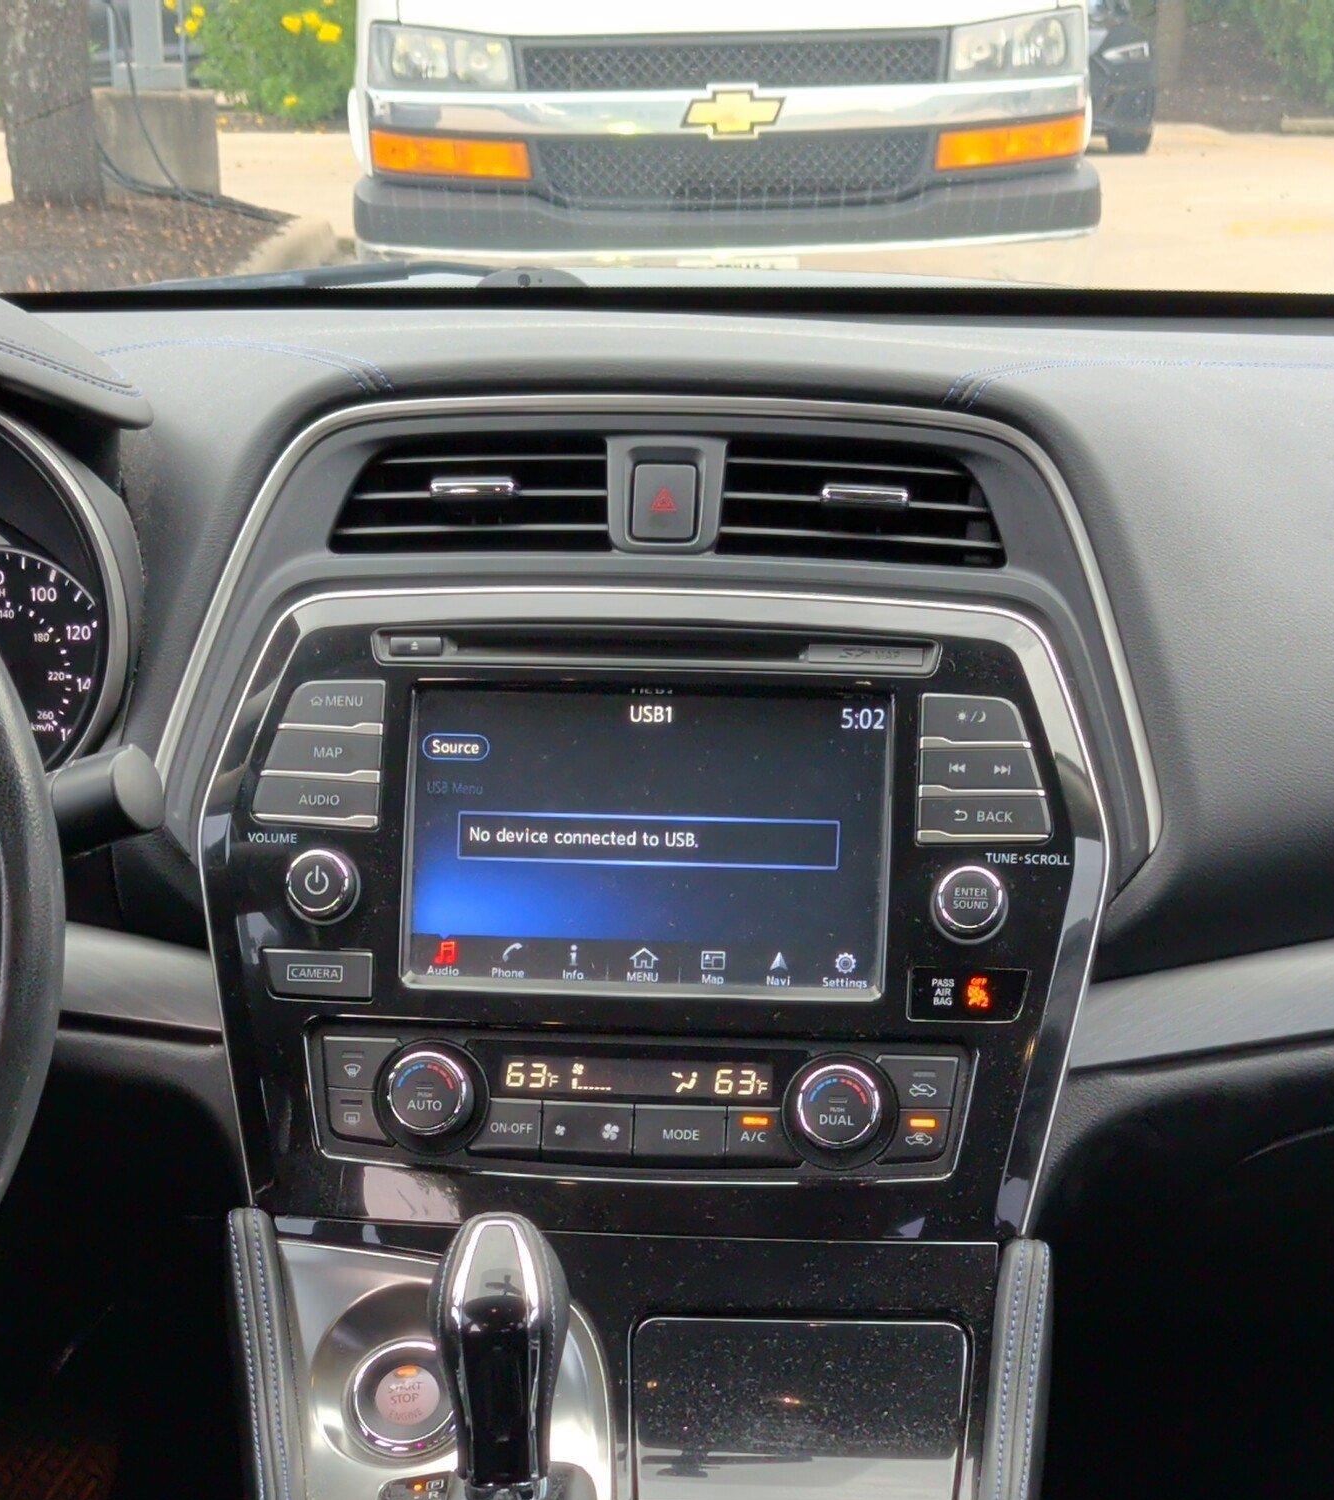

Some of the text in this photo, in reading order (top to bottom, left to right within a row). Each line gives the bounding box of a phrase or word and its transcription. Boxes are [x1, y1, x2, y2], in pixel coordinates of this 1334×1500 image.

[30, 587, 57, 602] 100
[33, 632, 50, 643] 180
[66, 625, 91, 641] 120
[47, 671, 65, 682] 220
[324, 695, 364, 707] MENU
[37, 710, 54, 721] 260
[629, 705, 673, 724] USB1
[840, 708, 885, 730] 5:02
[313, 747, 343, 759] MAP
[431, 739, 480, 755] Source
[426, 781, 484, 796] USB Menu
[298, 794, 340, 806] AUDIO
[976, 810, 1013, 823] BACK
[247, 832, 298, 844] VOLUME
[469, 826, 699, 849] No device connected to USB.
[954, 887, 988, 897] ENTER
[953, 899, 989, 910] SOUND
[291, 968, 340, 980] CAMERA
[426, 965, 460, 977] Audio
[491, 967, 525, 979] Phone
[562, 969, 584, 981] Info
[626, 972, 659, 983] MENU
[701, 974, 724, 985] Map
[766, 976, 791, 987] Navi
[822, 977, 868, 989] Settings
[931, 978, 955, 988] PASS
[935, 988, 952, 997] AIR
[933, 997, 953, 1006] BAG
[407, 1099, 443, 1112] AUTO
[819, 1114, 855, 1126] DUAL
[662, 1129, 700, 1142] MODE
[740, 1131, 767, 1143] A/C
[390, 1392, 420, 1405] STOP
[388, 1408, 423, 1422] ENGINE
[428, 1491, 439, 1499] R
